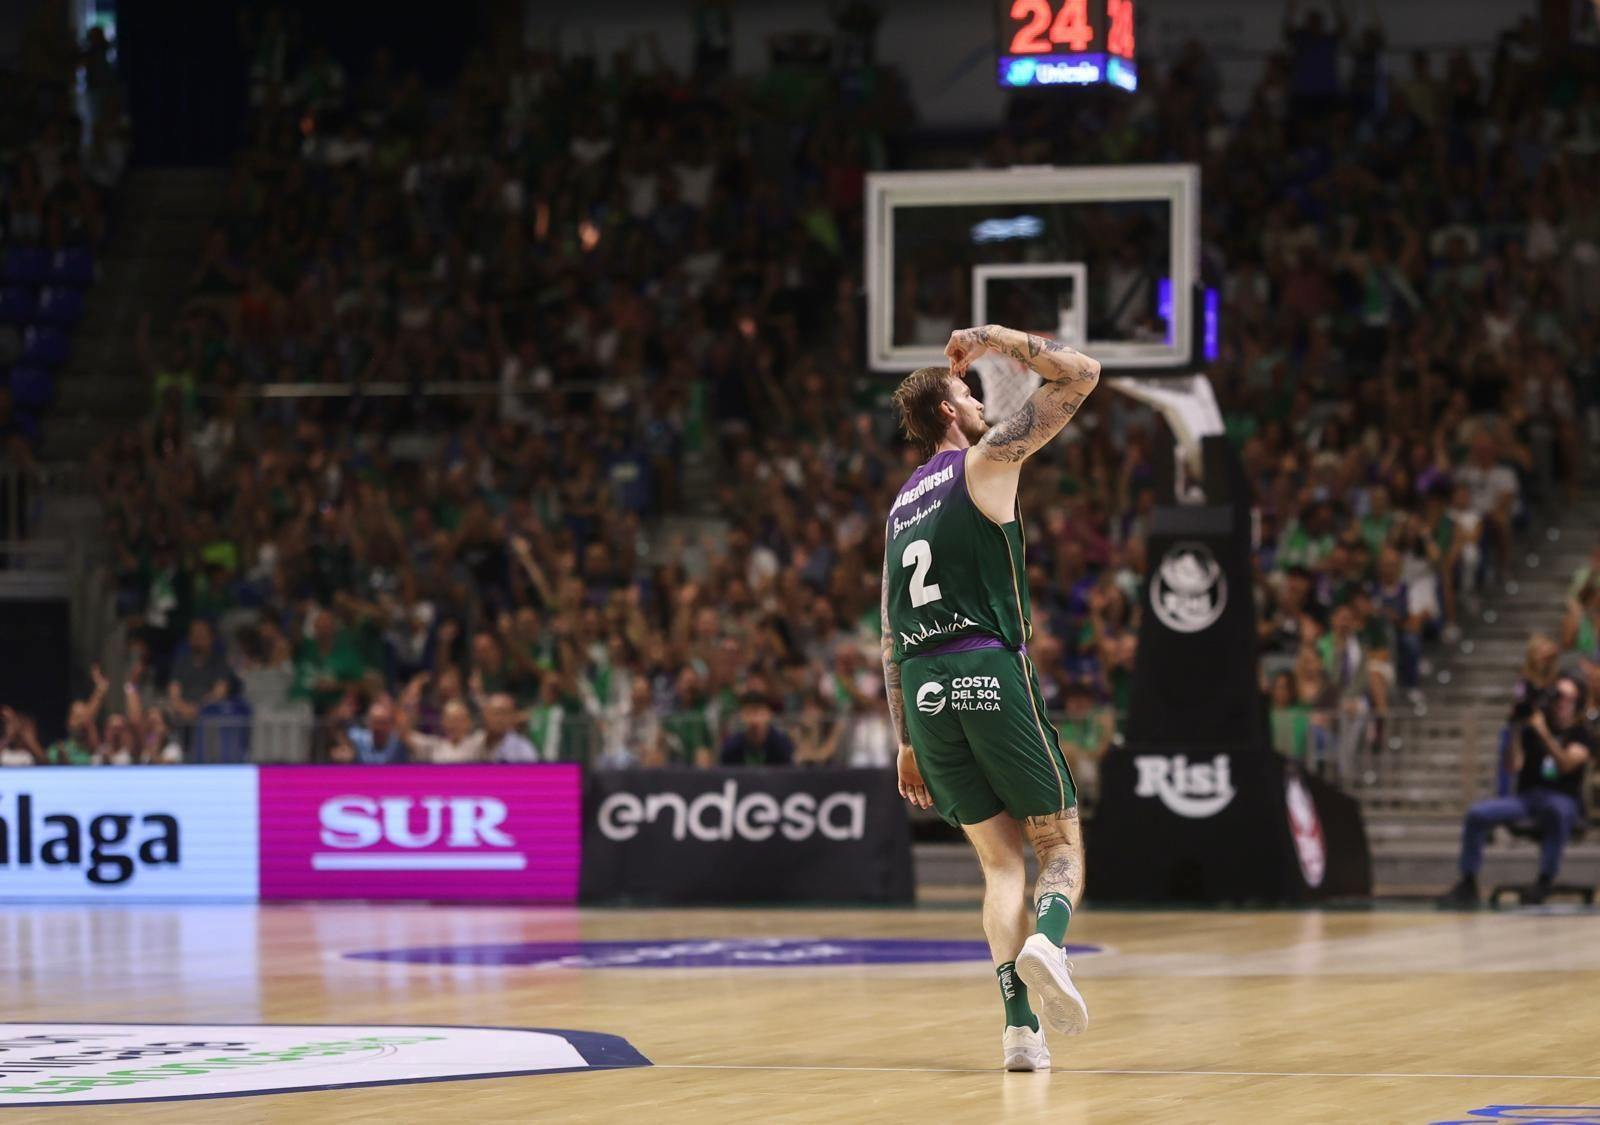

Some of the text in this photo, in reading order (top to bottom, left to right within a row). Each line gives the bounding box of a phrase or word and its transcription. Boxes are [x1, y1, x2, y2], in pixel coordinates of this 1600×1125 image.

[1010, 0, 1093, 54] 24
[902, 539, 942, 609] 2
[951, 676, 1001, 689] COSTA
[951, 689, 1001, 701] DEL SOL
[951, 699, 1001, 711] MÁLAGA
[598, 779, 867, 842] endesa
[1134, 753, 1238, 818] Risi
[0, 793, 181, 884] laga
[318, 796, 515, 848] SUR
